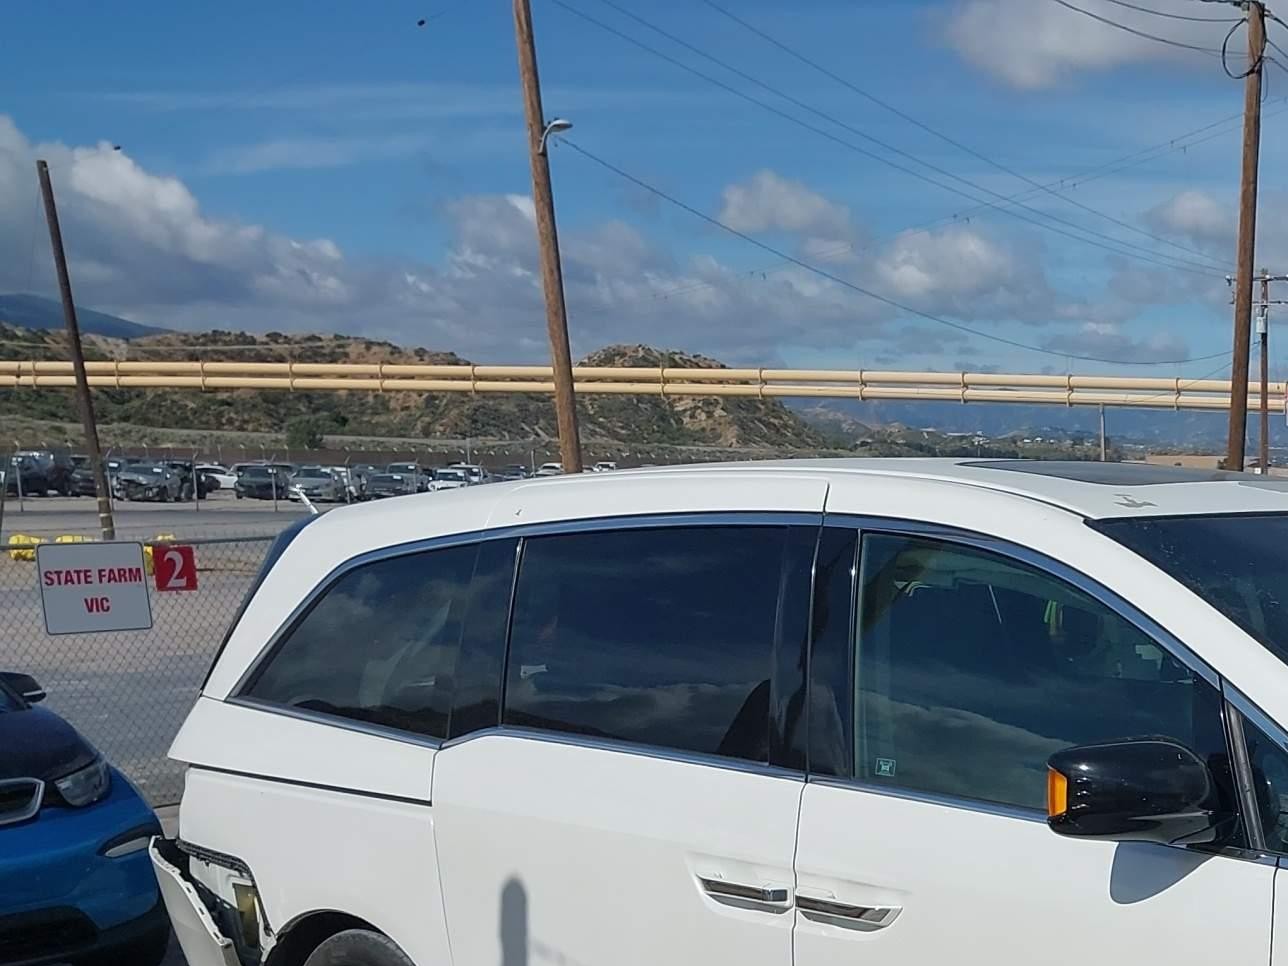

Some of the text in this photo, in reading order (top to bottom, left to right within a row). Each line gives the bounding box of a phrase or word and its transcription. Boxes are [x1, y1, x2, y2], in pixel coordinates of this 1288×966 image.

[43, 567, 142, 586] STATE FARM
[164, 550, 187, 588] 2
[84, 597, 111, 613] VIC
